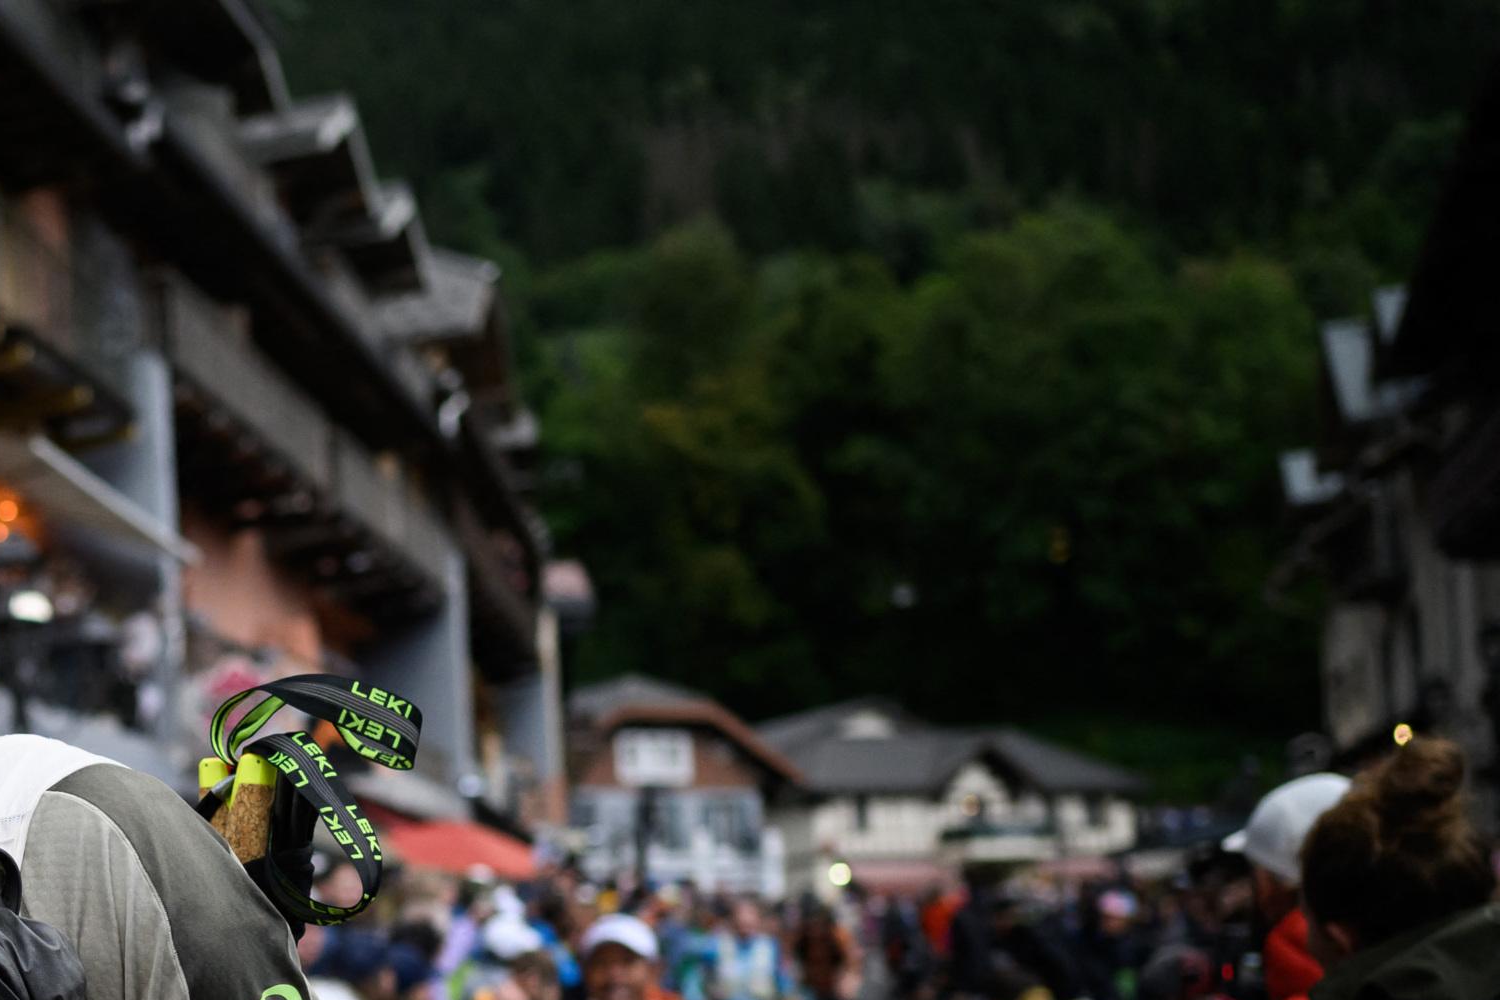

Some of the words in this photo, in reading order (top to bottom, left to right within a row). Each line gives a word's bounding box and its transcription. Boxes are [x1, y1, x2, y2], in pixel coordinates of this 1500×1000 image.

[351, 681, 413, 719] LEKI
[338, 709, 402, 749] LEKI
[268, 751, 310, 788] LEKI
[291, 731, 338, 778] LEKI
[319, 806, 364, 860] LEKI
[345, 804, 382, 861] LEKI
